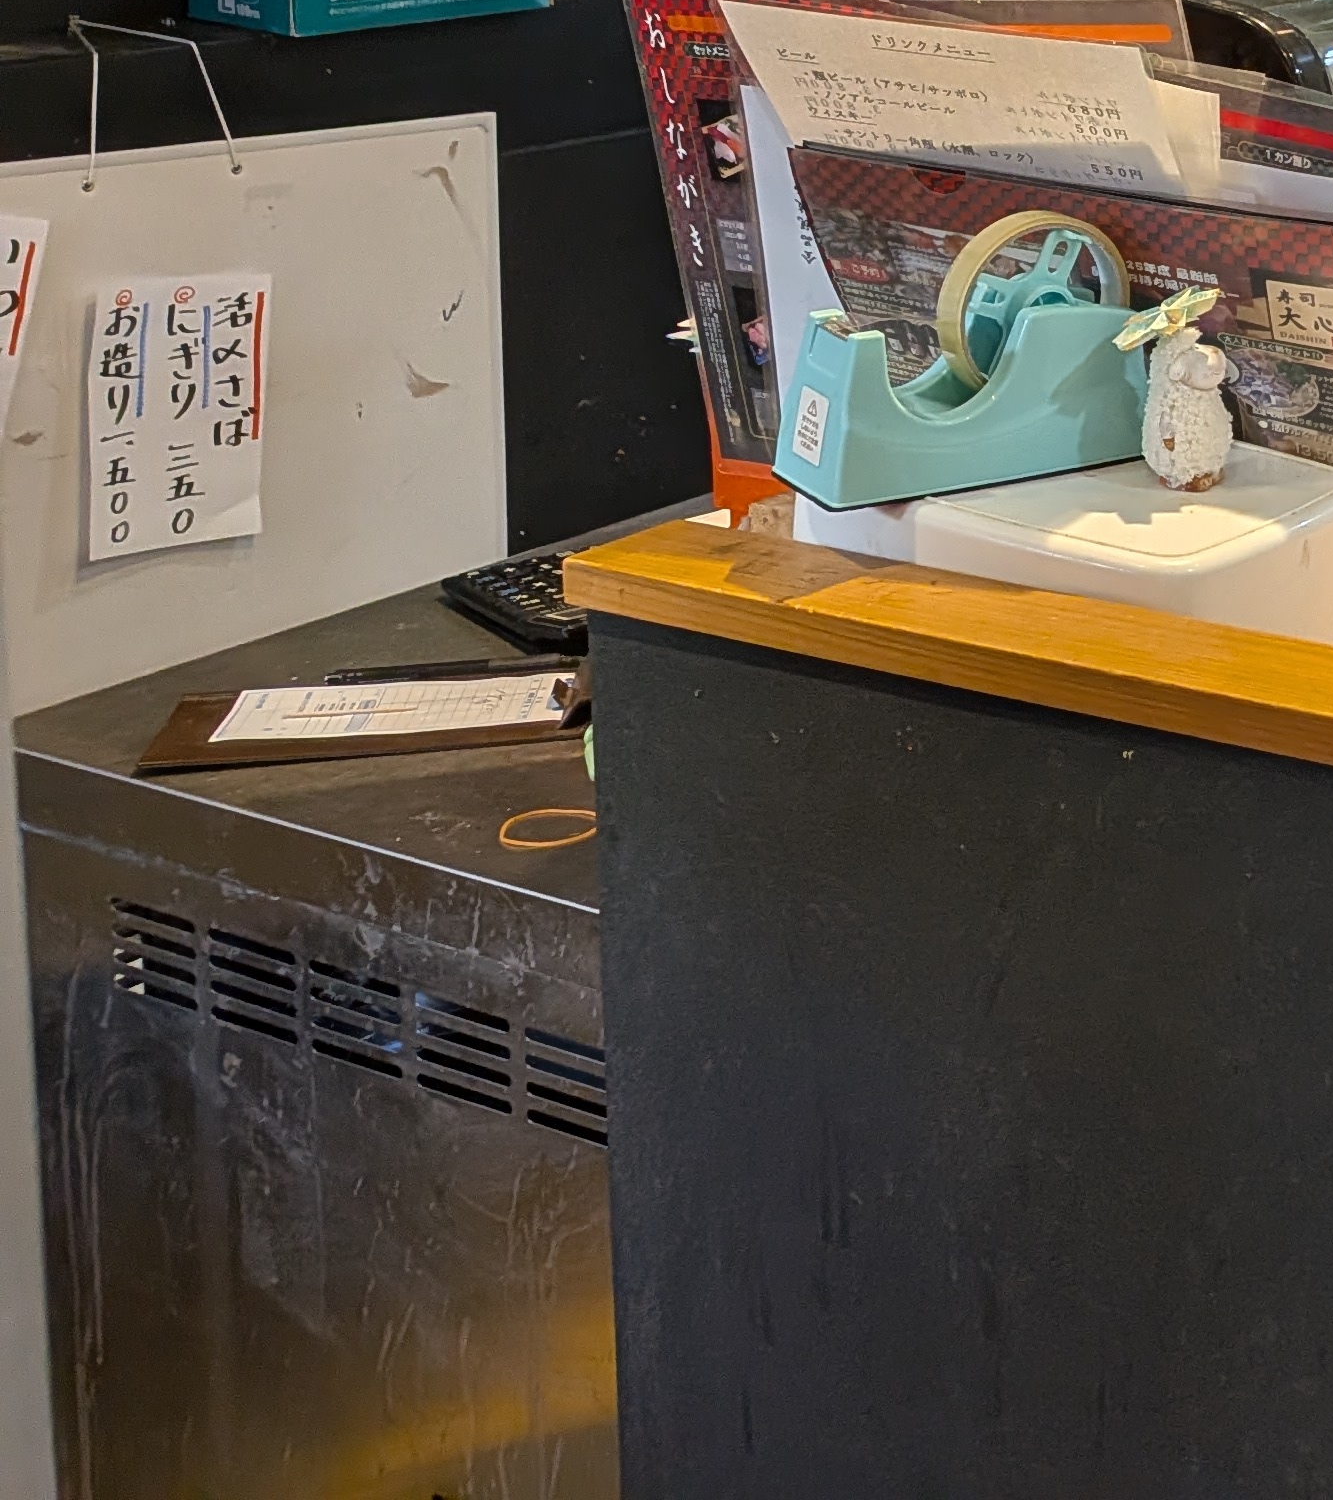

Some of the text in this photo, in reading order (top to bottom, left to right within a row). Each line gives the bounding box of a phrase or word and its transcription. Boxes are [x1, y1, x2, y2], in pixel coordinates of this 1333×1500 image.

[776, 48, 817, 61] ビール
[871, 34, 991, 57] ドリンクメニュー
[644, 8, 705, 268] おしながき
[1074, 122, 1129, 141] 500円
[1276, 288, 1316, 308] 寿司
[1279, 331, 1328, 345] DAISHIN
[100, 304, 141, 425] お造り
[166, 303, 207, 421] にぎり
[212, 291, 258, 447] 活〆さば
